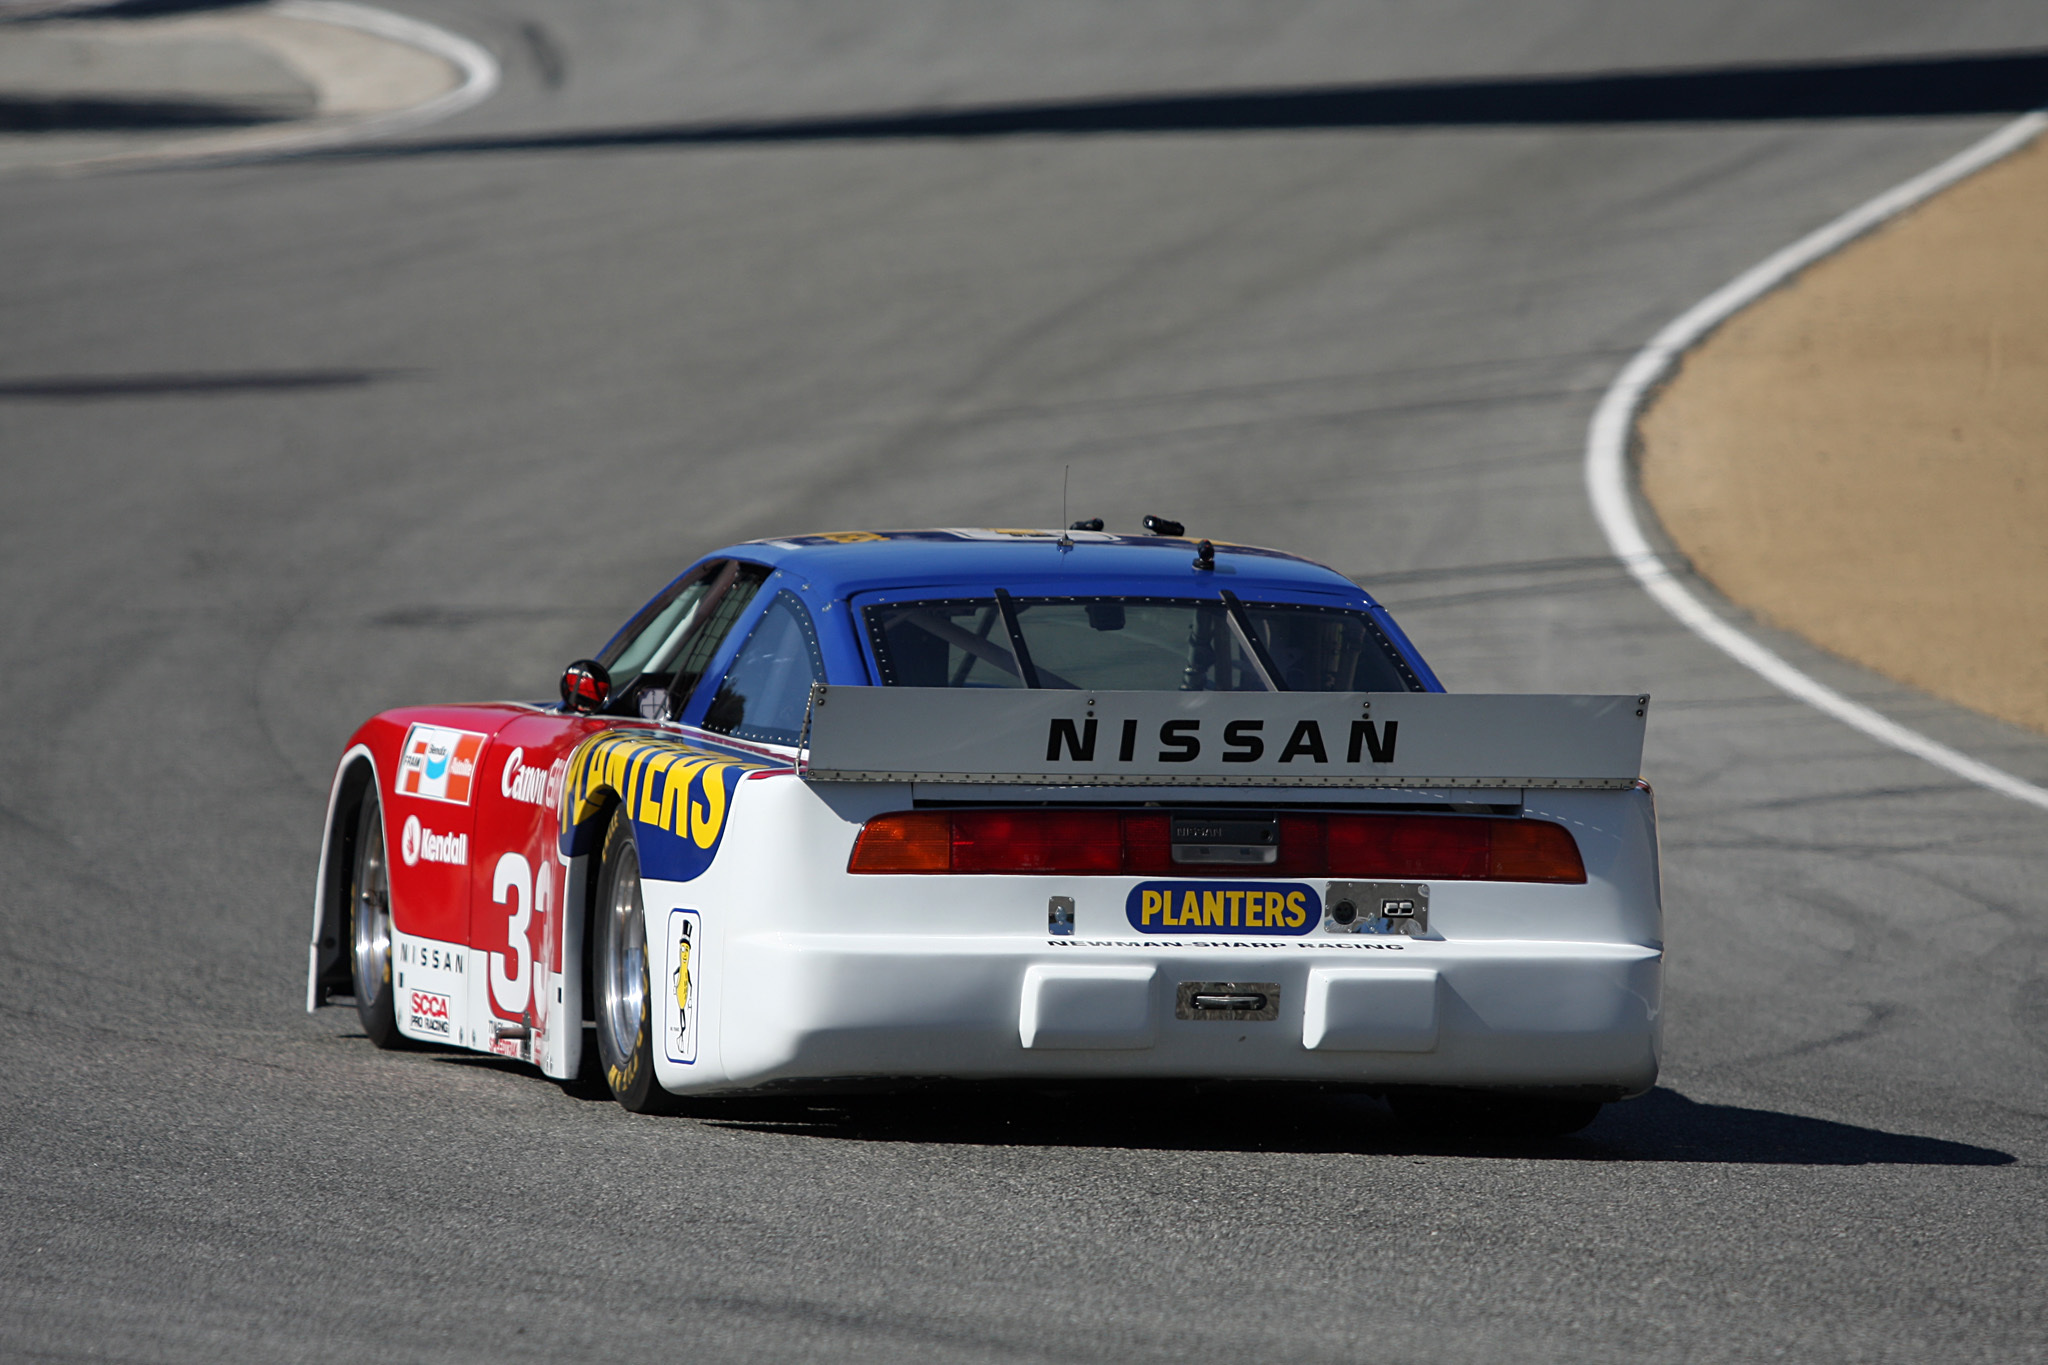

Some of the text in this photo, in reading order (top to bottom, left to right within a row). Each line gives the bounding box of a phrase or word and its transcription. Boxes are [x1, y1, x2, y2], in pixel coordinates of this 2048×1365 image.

[1046, 718, 1398, 763] NISSAN
[403, 754, 421, 768] FRAM
[501, 746, 548, 805] Canon
[420, 827, 468, 866] Kendall
[1141, 890, 1306, 928] PLANTERS
[400, 943, 464, 974] NISSAN
[1047, 940, 1287, 948] NEWMAN-SHARP
[411, 992, 449, 1019] SCCA
[410, 1015, 449, 1033] PRO RACING
